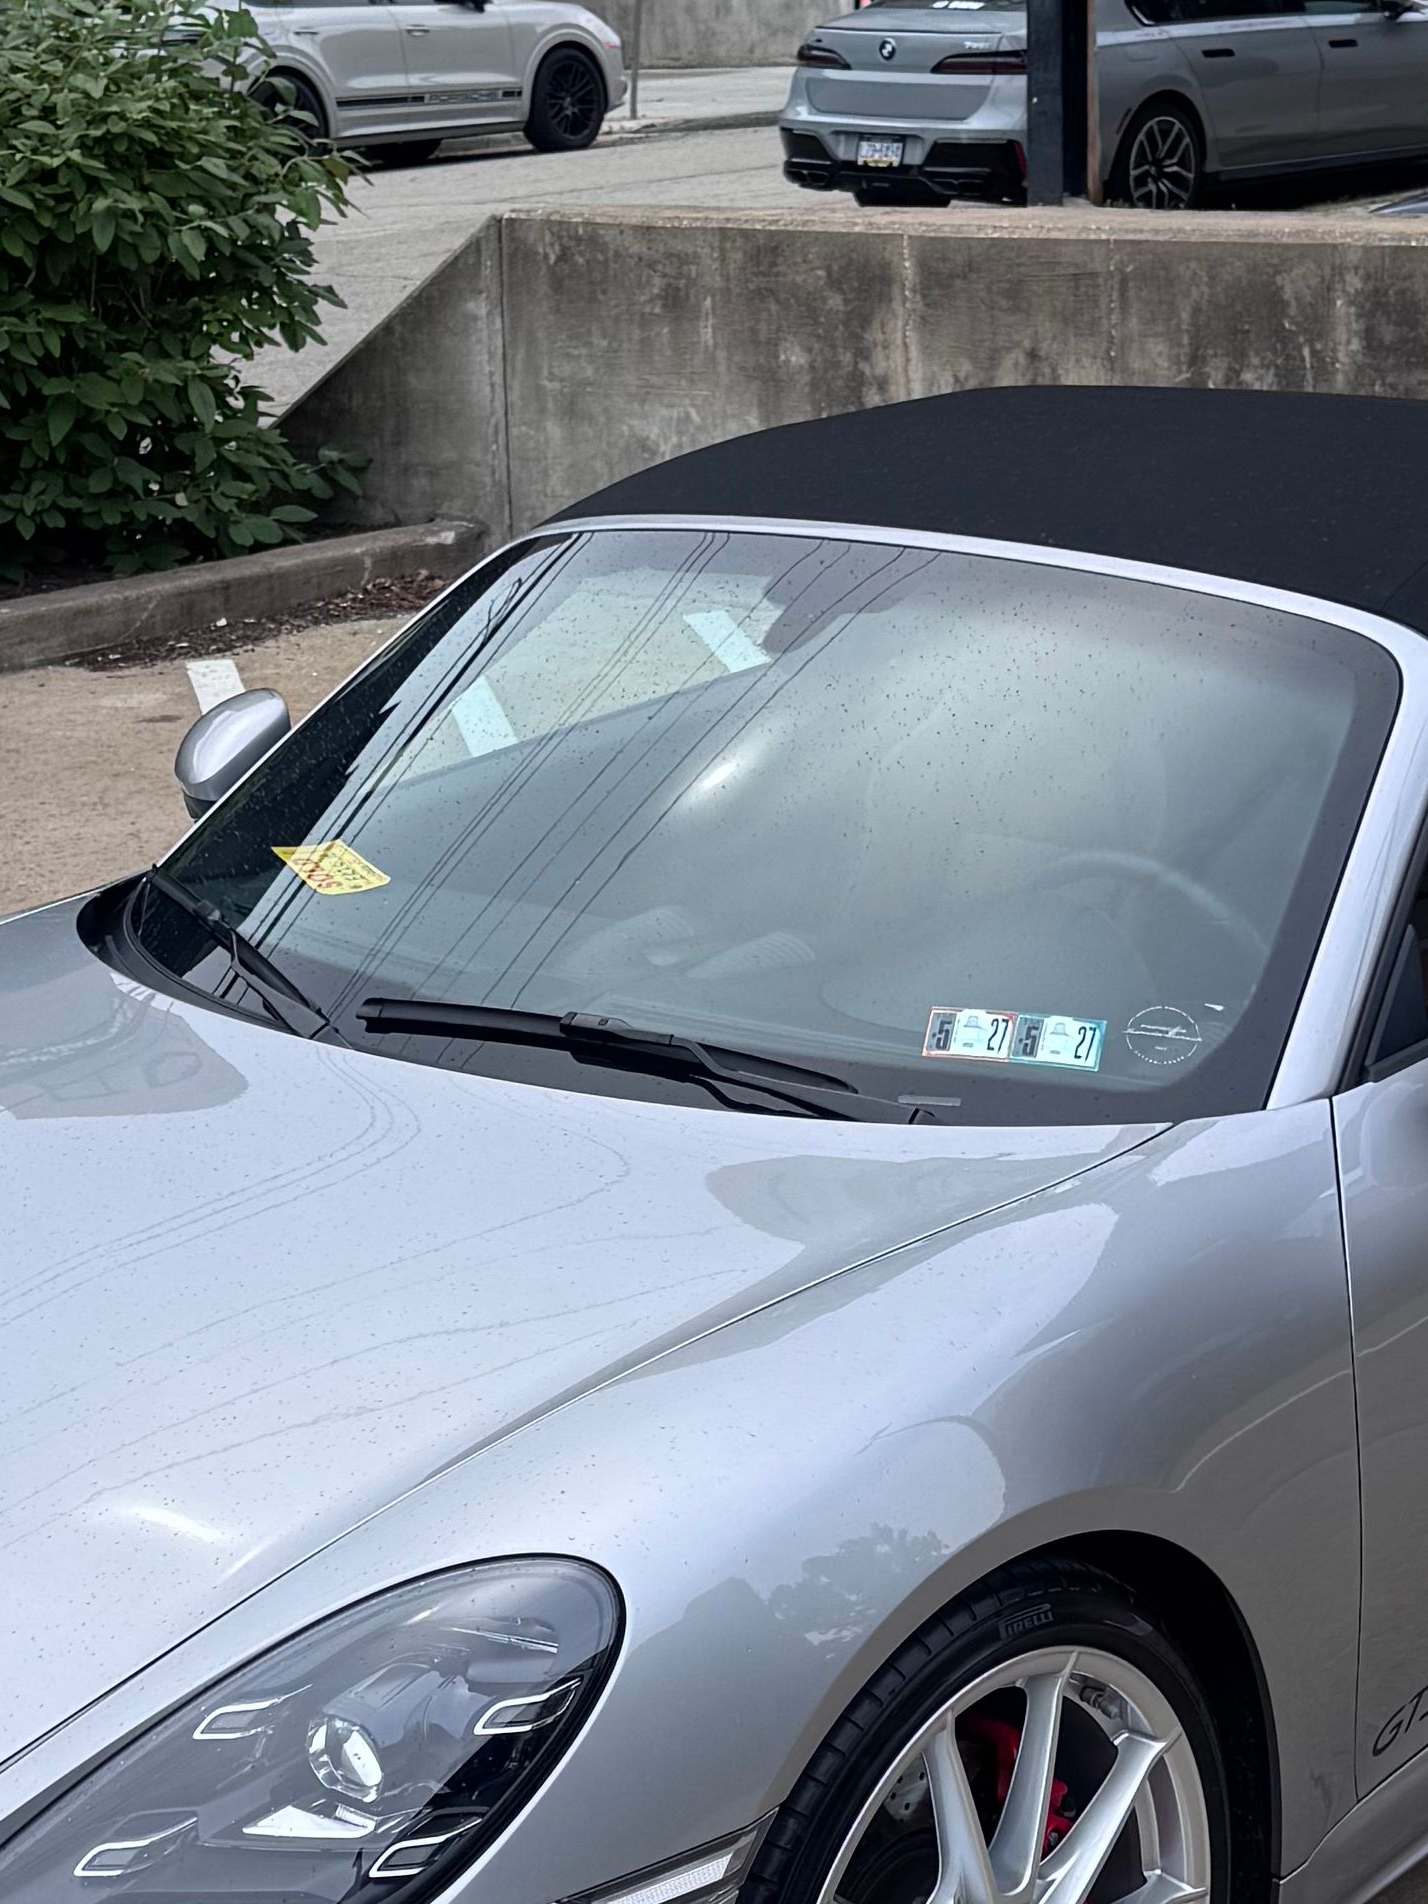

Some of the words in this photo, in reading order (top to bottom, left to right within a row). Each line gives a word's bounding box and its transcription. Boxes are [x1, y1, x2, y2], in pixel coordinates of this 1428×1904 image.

[986, 1018, 1010, 1055] 27
[1073, 1026, 1098, 1063] 27
[998, 1603, 1053, 1640] PIRELLI
